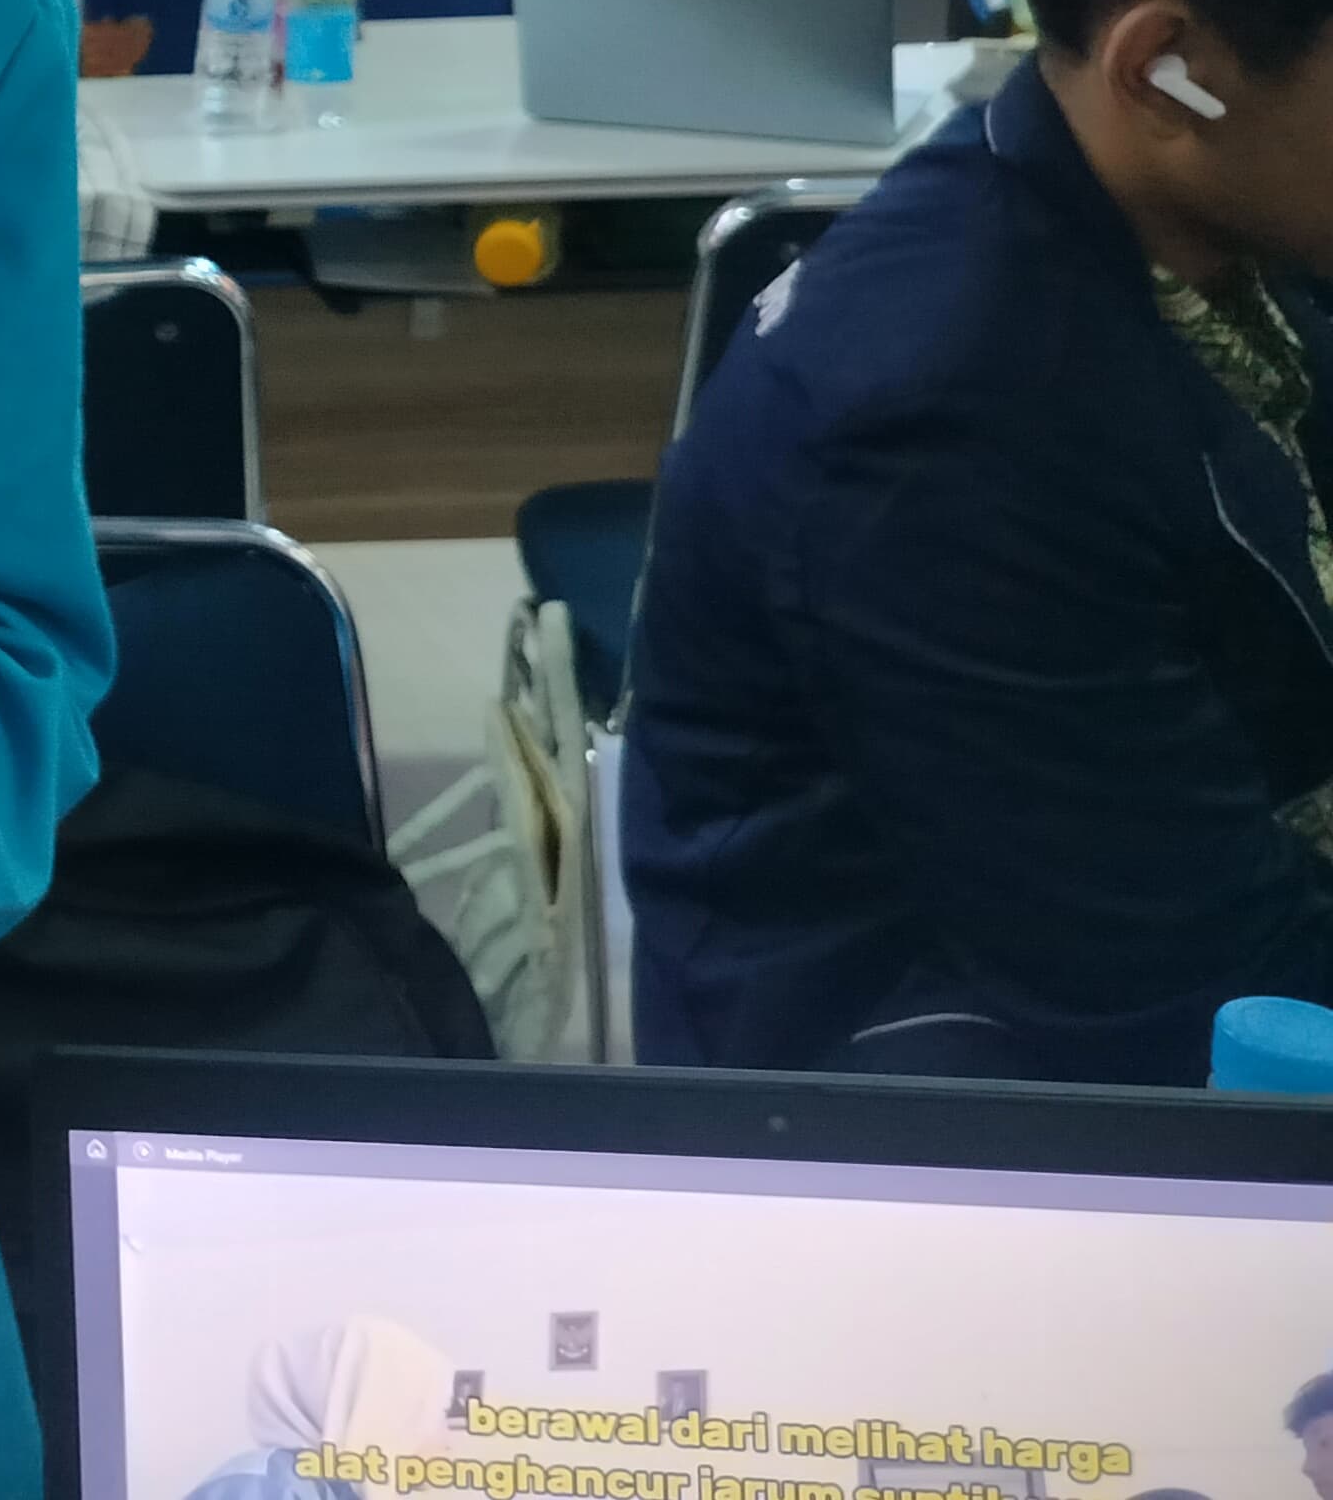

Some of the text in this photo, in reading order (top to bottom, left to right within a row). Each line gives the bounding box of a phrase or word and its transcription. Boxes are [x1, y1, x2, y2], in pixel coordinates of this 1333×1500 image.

[165, 1147, 243, 1165] Media Player
[294, 1440, 390, 1484] alat
[395, 1454, 689, 1500] penghancur
[467, 1396, 1132, 1484] berawal dari melihat harga
